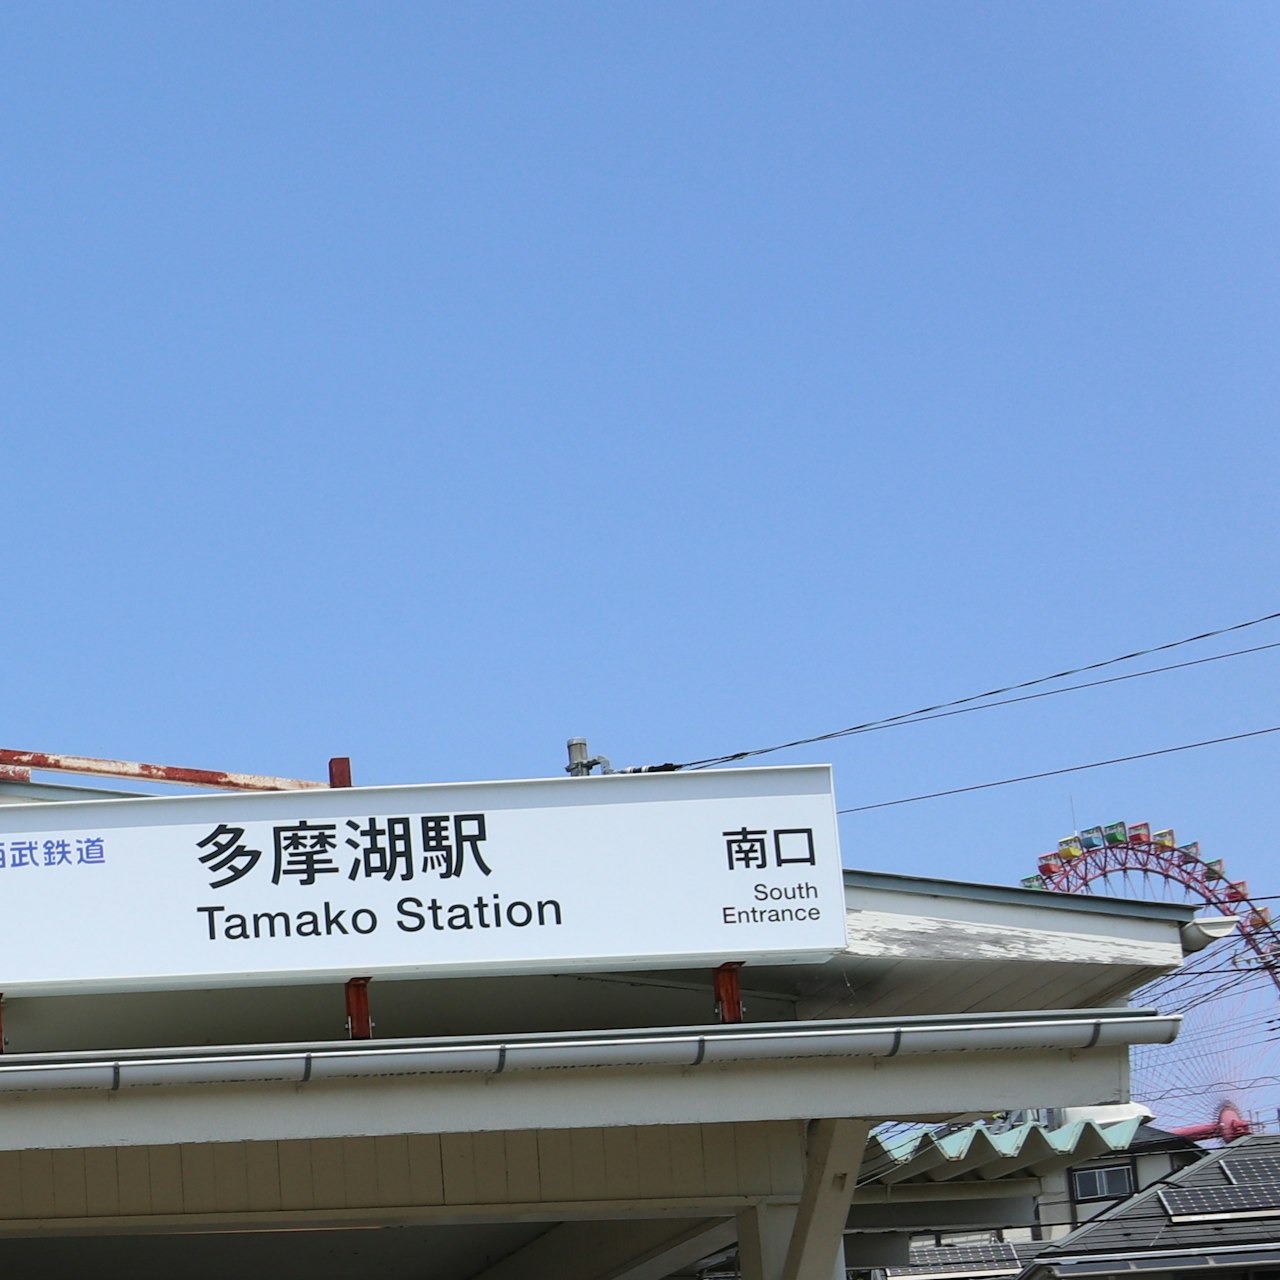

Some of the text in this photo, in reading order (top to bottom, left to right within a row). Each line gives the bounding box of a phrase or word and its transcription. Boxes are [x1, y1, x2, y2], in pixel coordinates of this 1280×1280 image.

[195, 813, 492, 889] 多摩湖駅
[722, 826, 816, 871] 南口
[753, 881, 818, 902] South
[196, 893, 562, 941] Tamako Station
[722, 906, 821, 925] Entrance
